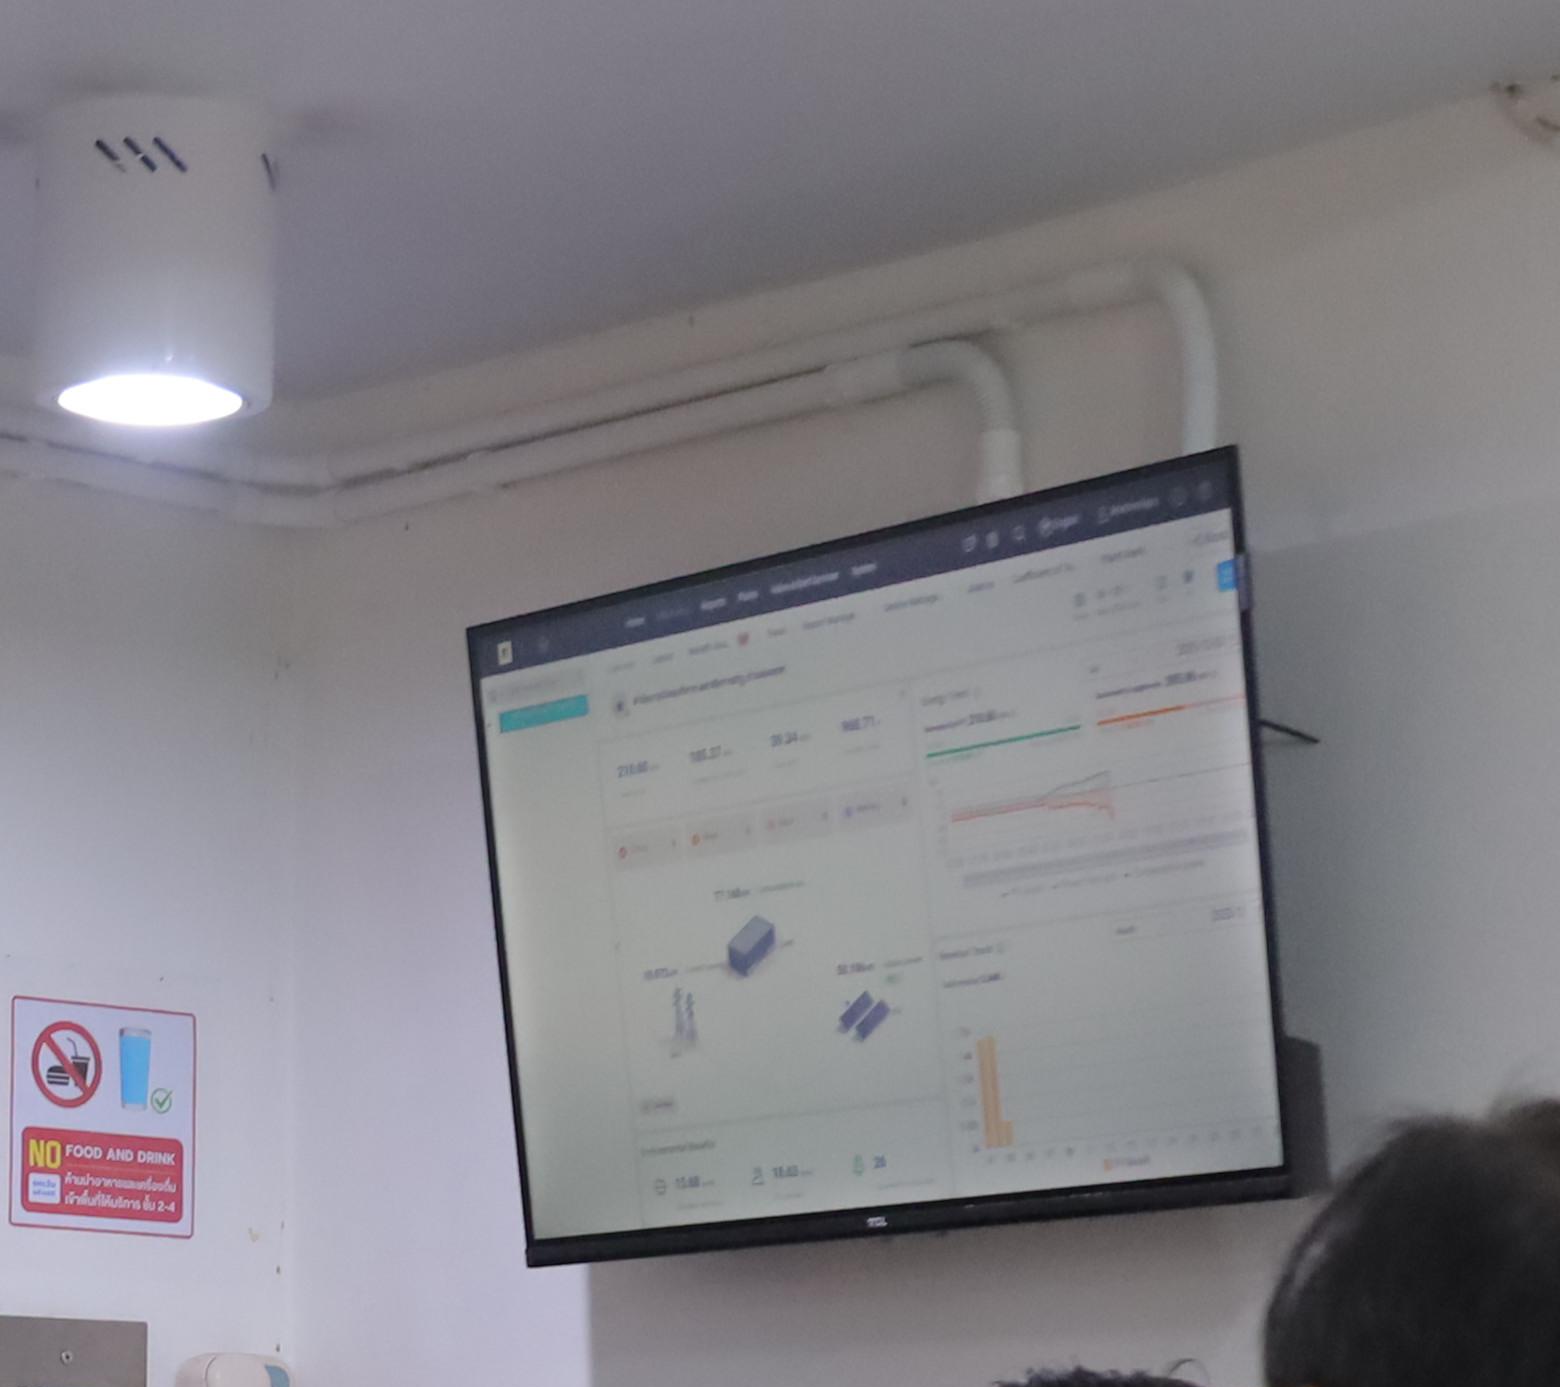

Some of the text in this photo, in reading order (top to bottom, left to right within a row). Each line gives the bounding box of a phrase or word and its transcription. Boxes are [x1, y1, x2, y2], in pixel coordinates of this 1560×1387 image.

[29, 1139, 176, 1169] NO FOOD AND DRINK
[157, 1201, 176, 1213] 2-4
